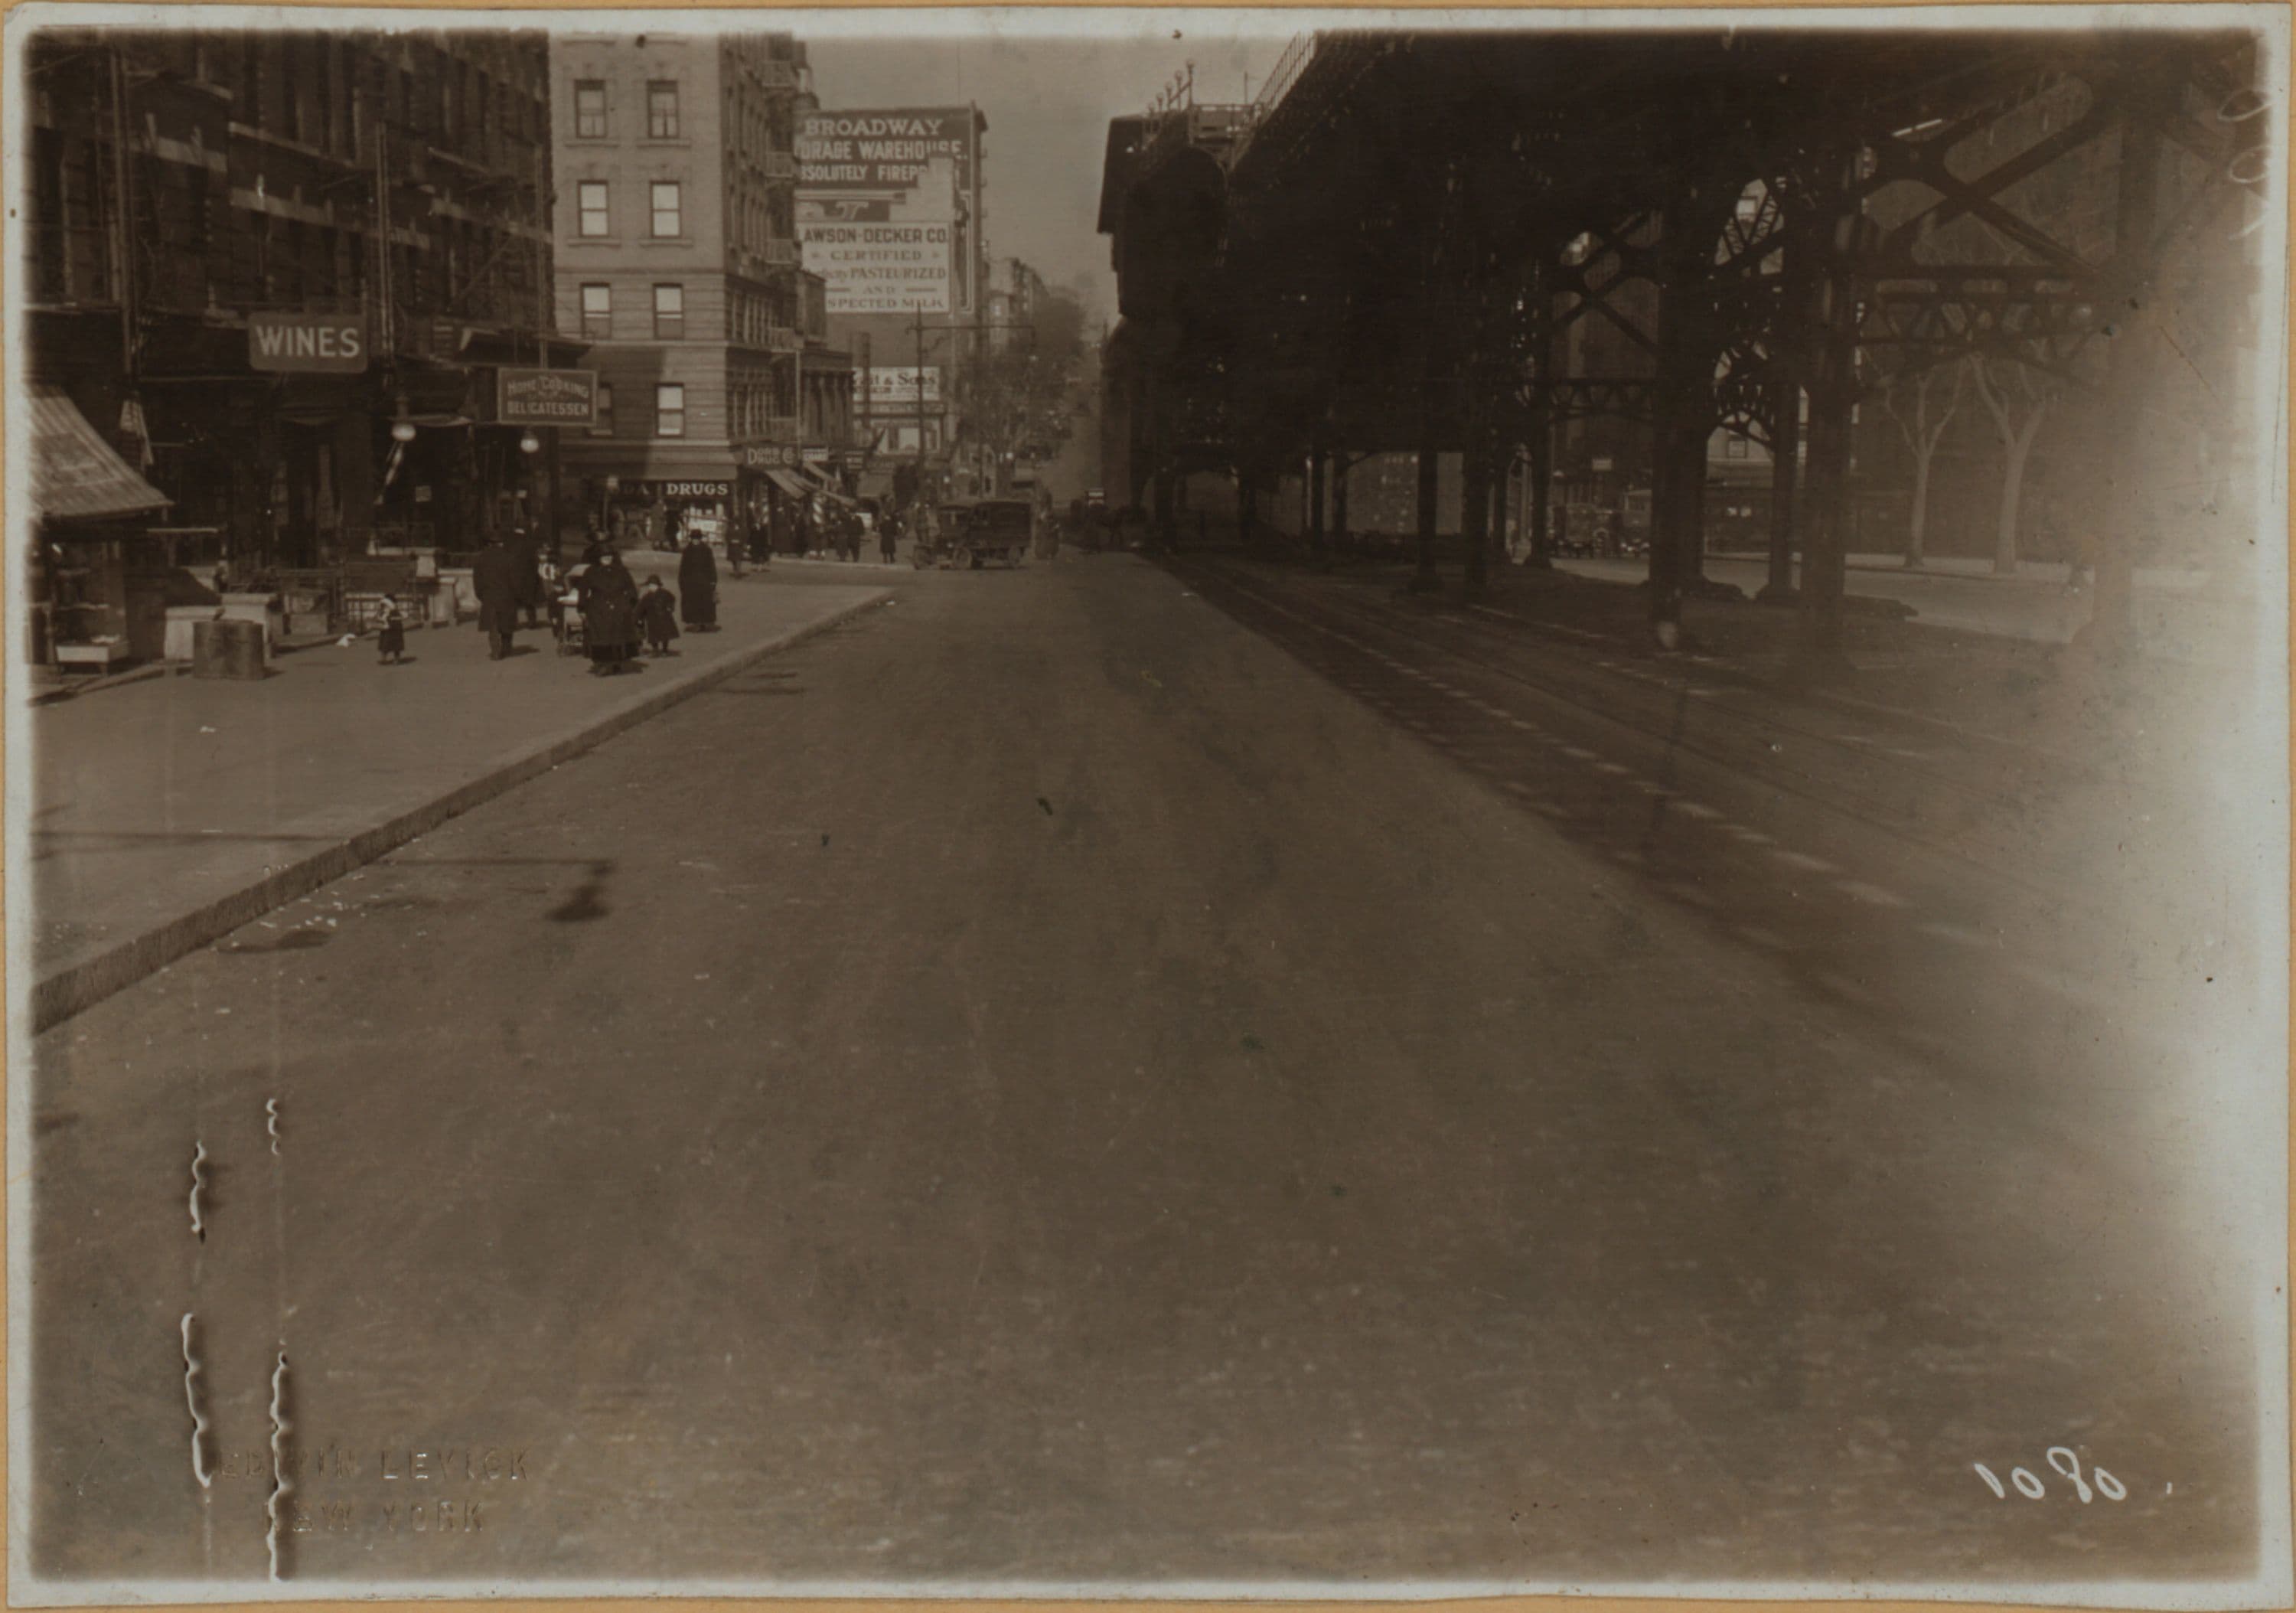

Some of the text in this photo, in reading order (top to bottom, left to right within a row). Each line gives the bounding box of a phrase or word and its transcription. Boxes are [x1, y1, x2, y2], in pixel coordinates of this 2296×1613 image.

[804, 118, 944, 135] BROADWAY
[830, 250, 921, 261] CERTIFIED
[850, 268, 946, 279] PASTEURIZED
[256, 327, 360, 358] WINES
[507, 400, 589, 416] DELICATESSEN
[666, 482, 729, 496] DRUGS
